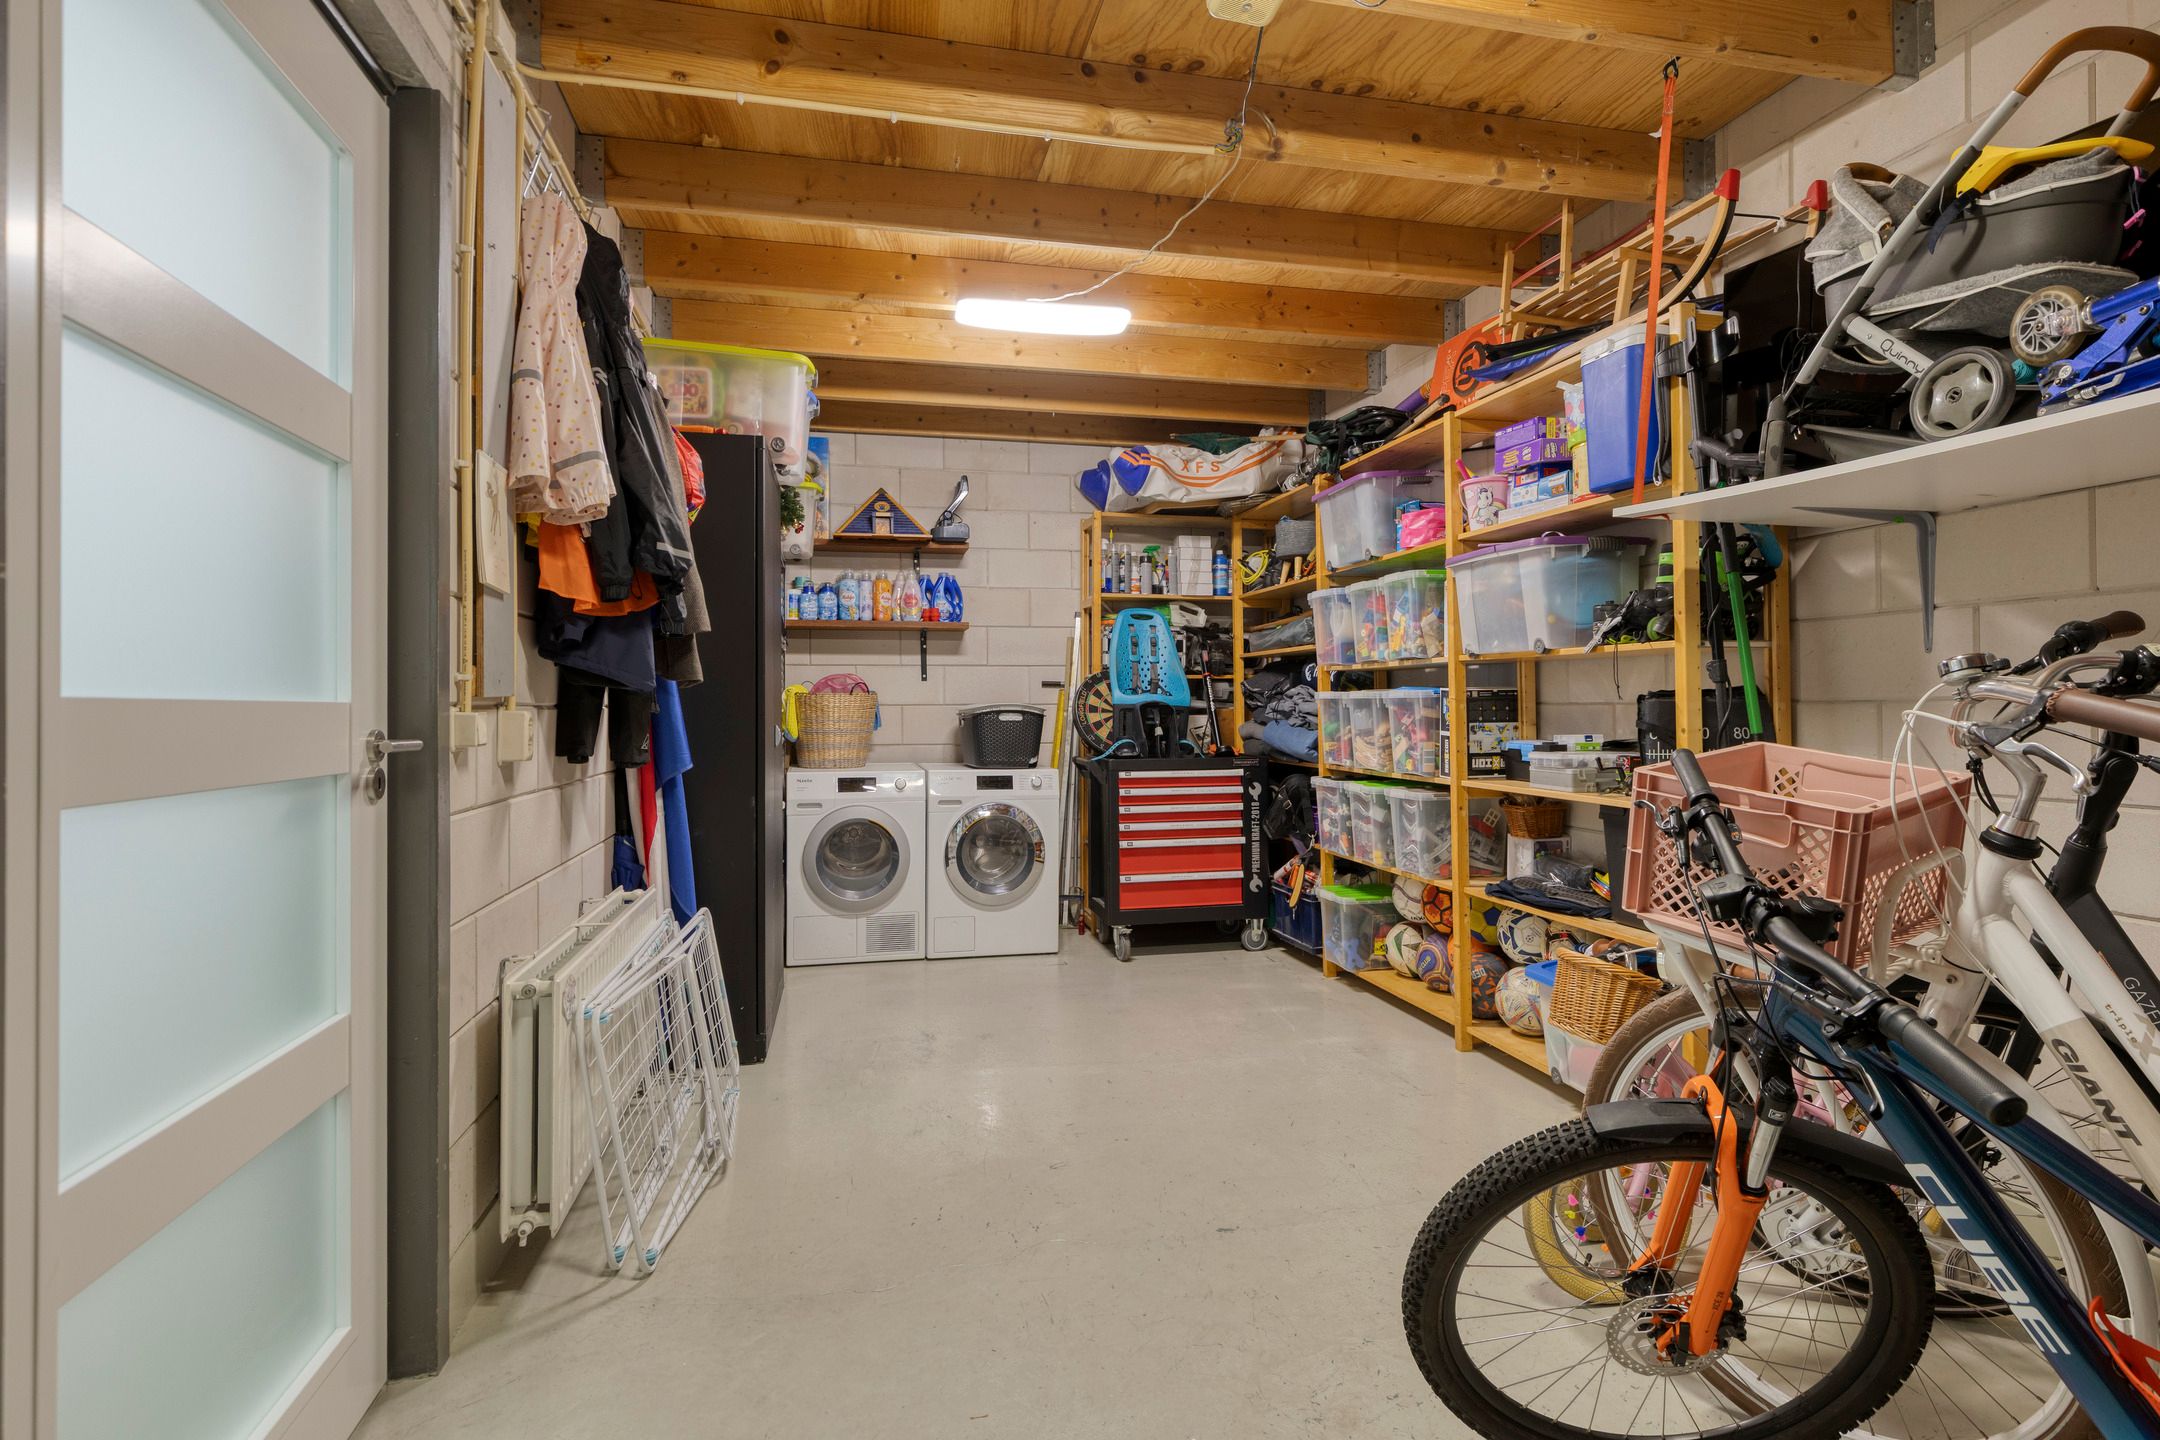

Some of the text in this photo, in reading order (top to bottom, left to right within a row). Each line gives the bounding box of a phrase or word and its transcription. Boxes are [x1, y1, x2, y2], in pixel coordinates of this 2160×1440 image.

[1880, 339, 1926, 374] Quinny
[1733, 727, 1750, 740] 80
[1250, 801, 1261, 873] PREMIUM KRAFT-2018
[2104, 1003, 2138, 1044] triple
[2123, 976, 2160, 1025] GAZE
[2051, 1038, 2143, 1147] GIANT
[1904, 1162, 2071, 1356] CUBE
